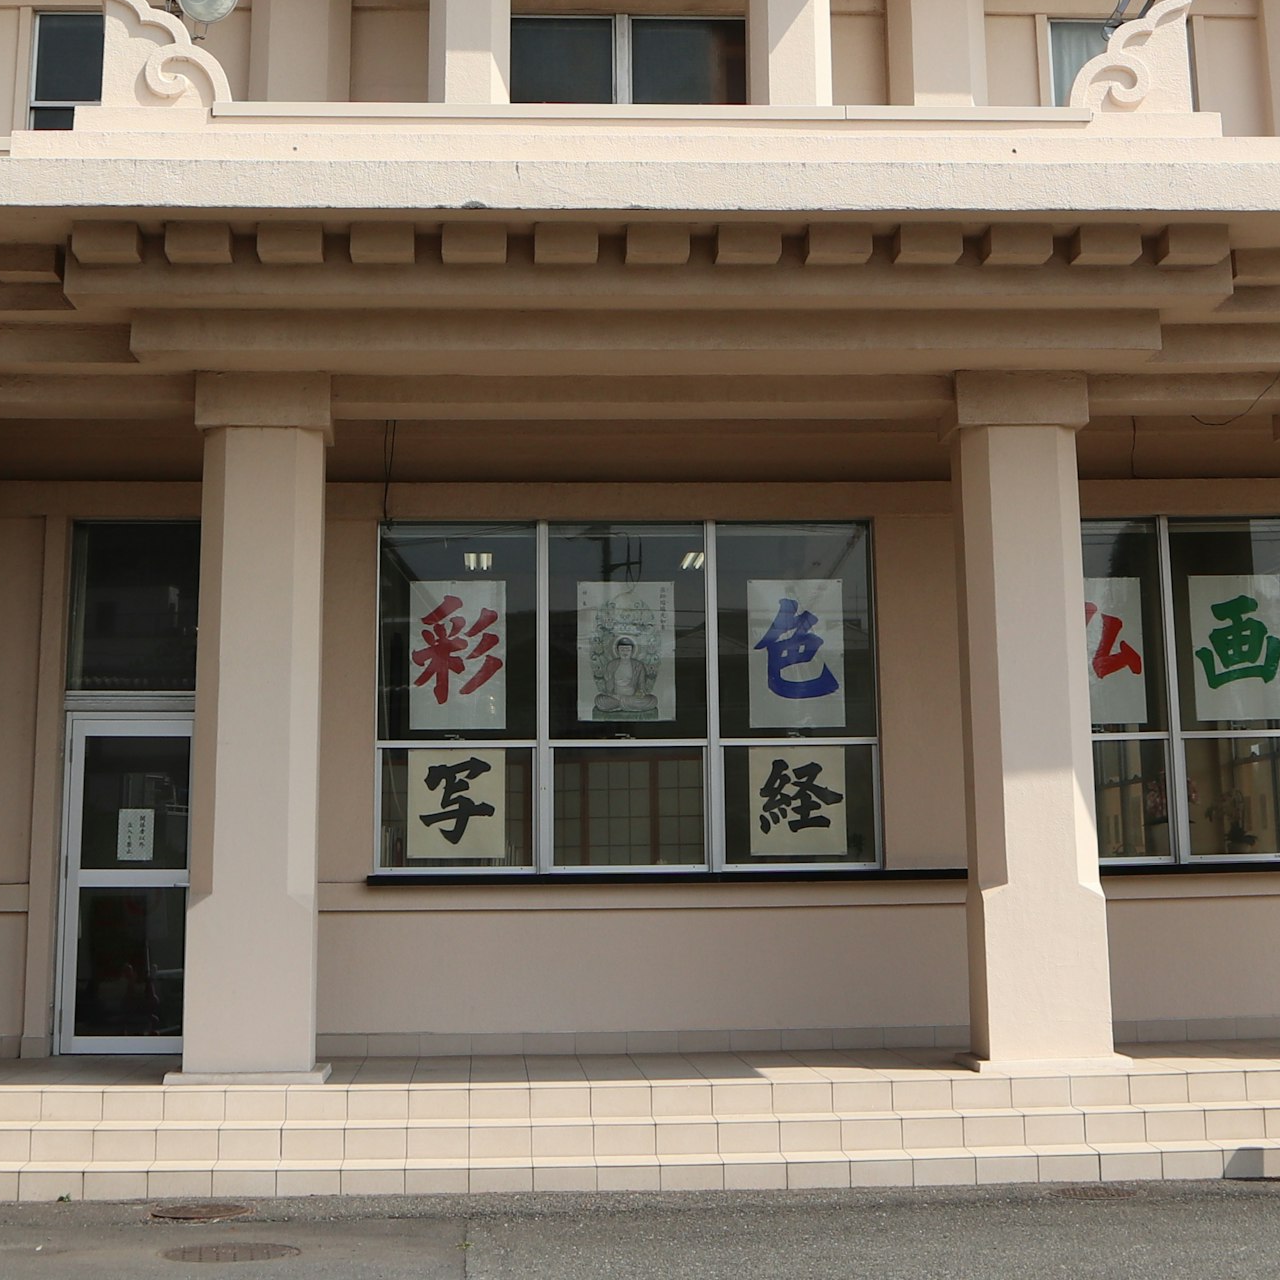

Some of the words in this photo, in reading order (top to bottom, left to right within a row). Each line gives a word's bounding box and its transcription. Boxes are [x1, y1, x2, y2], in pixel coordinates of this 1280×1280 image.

[412, 595, 504, 705] 彩
[754, 598, 840, 699] 色
[418, 756, 495, 845] 写
[759, 758, 844, 835] 経
